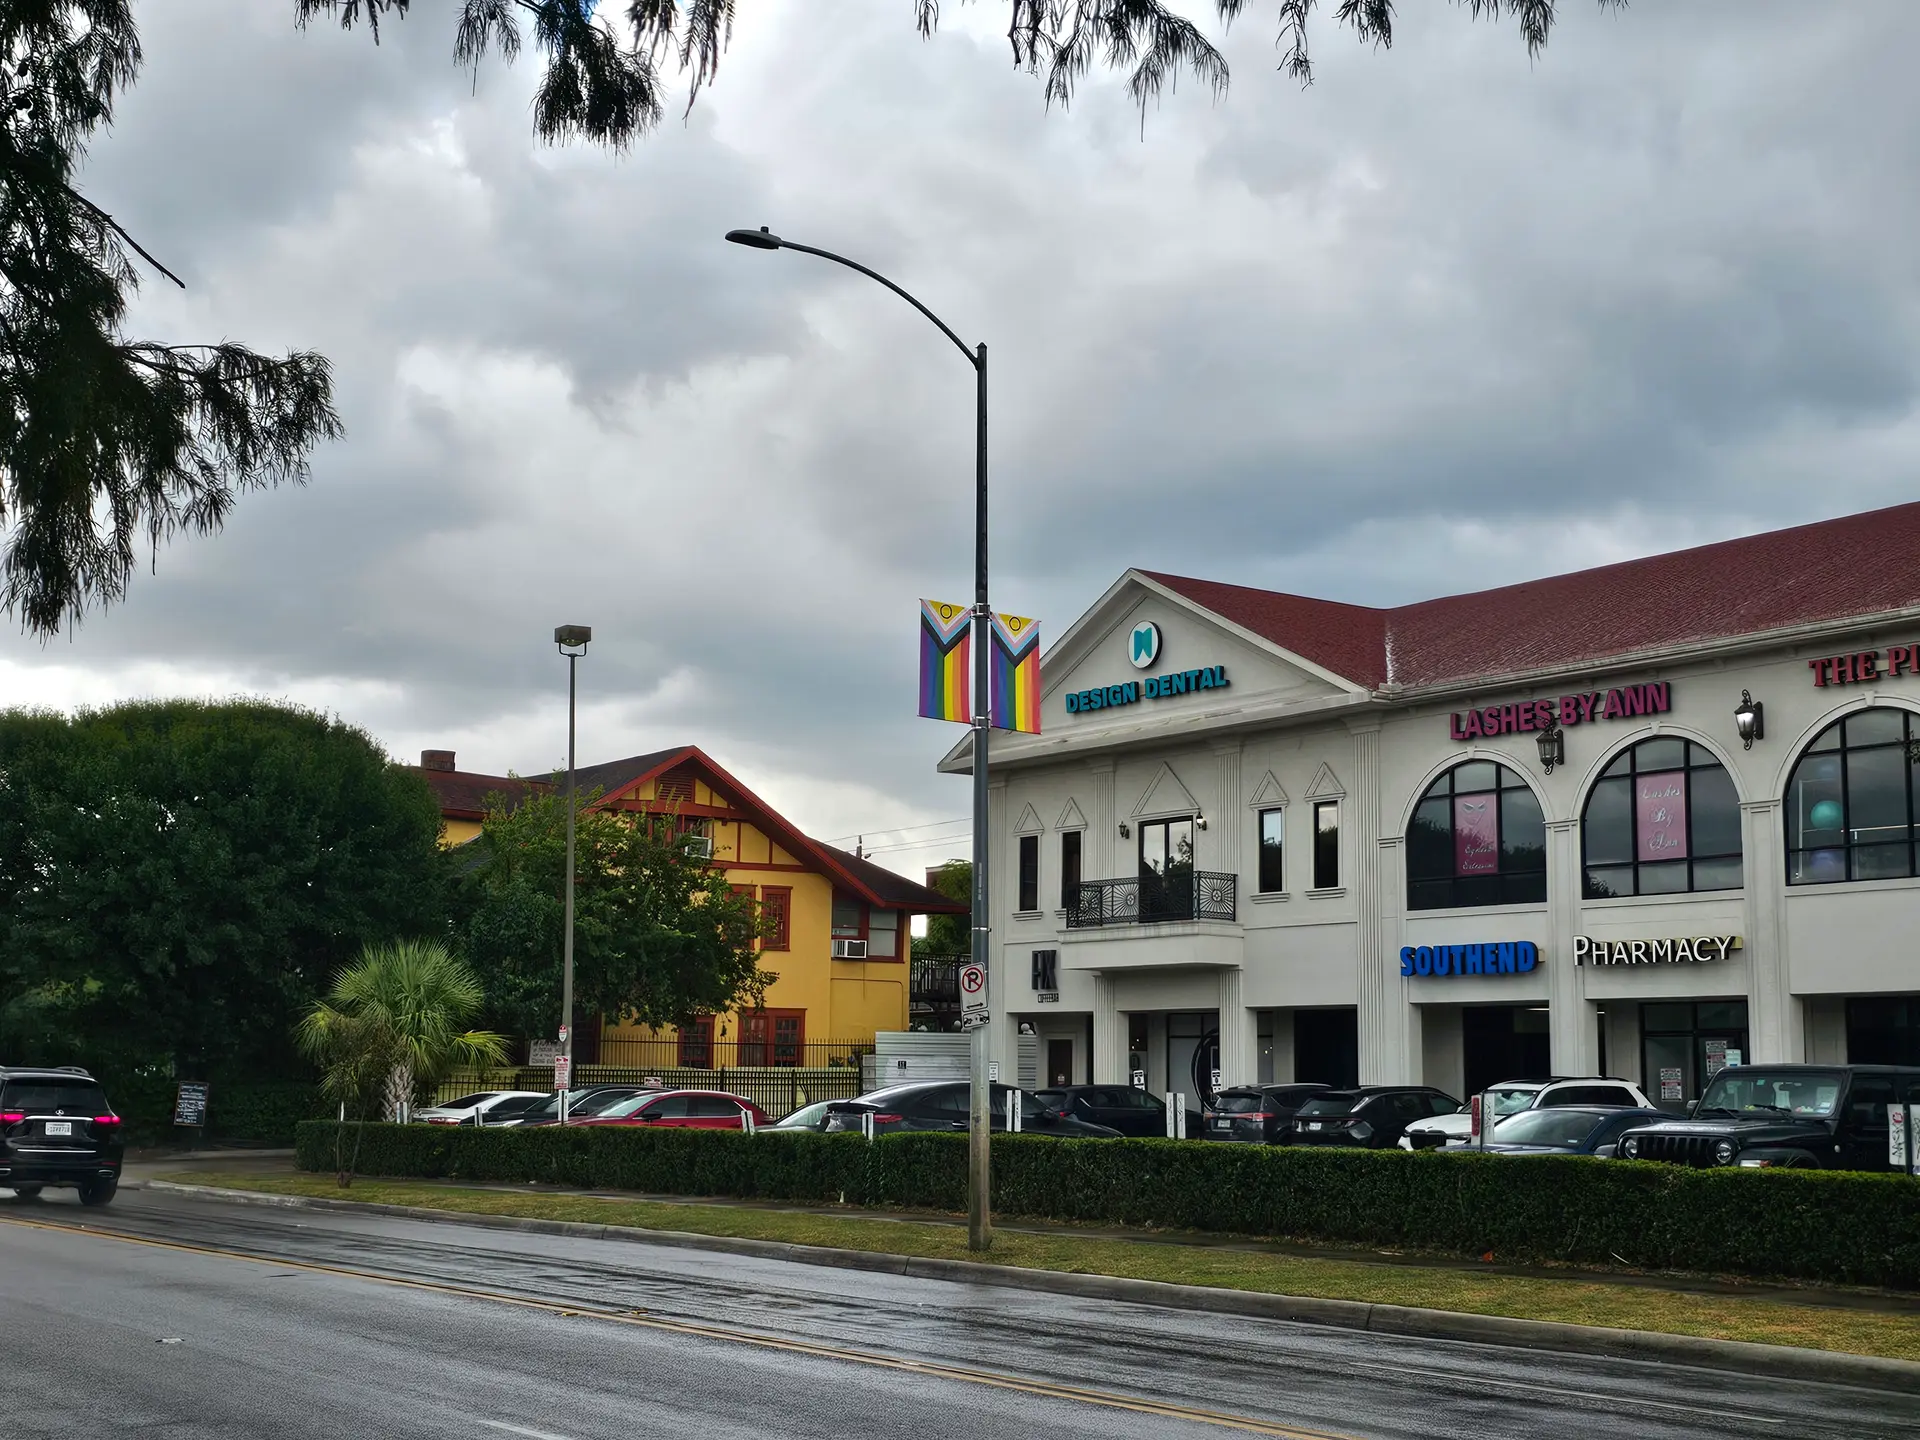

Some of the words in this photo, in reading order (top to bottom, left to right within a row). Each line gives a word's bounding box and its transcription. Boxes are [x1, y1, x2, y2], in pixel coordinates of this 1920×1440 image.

[1065, 681, 1140, 714] DESIGN
[1144, 665, 1230, 700] DENTAL
[1808, 650, 1878, 688] THE
[1450, 700, 1555, 740] LASHES
[1559, 691, 1600, 726] BY
[1602, 681, 1671, 720] ANN
[1031, 949, 1058, 990] FIX
[1400, 940, 1539, 977] SOUTHEND
